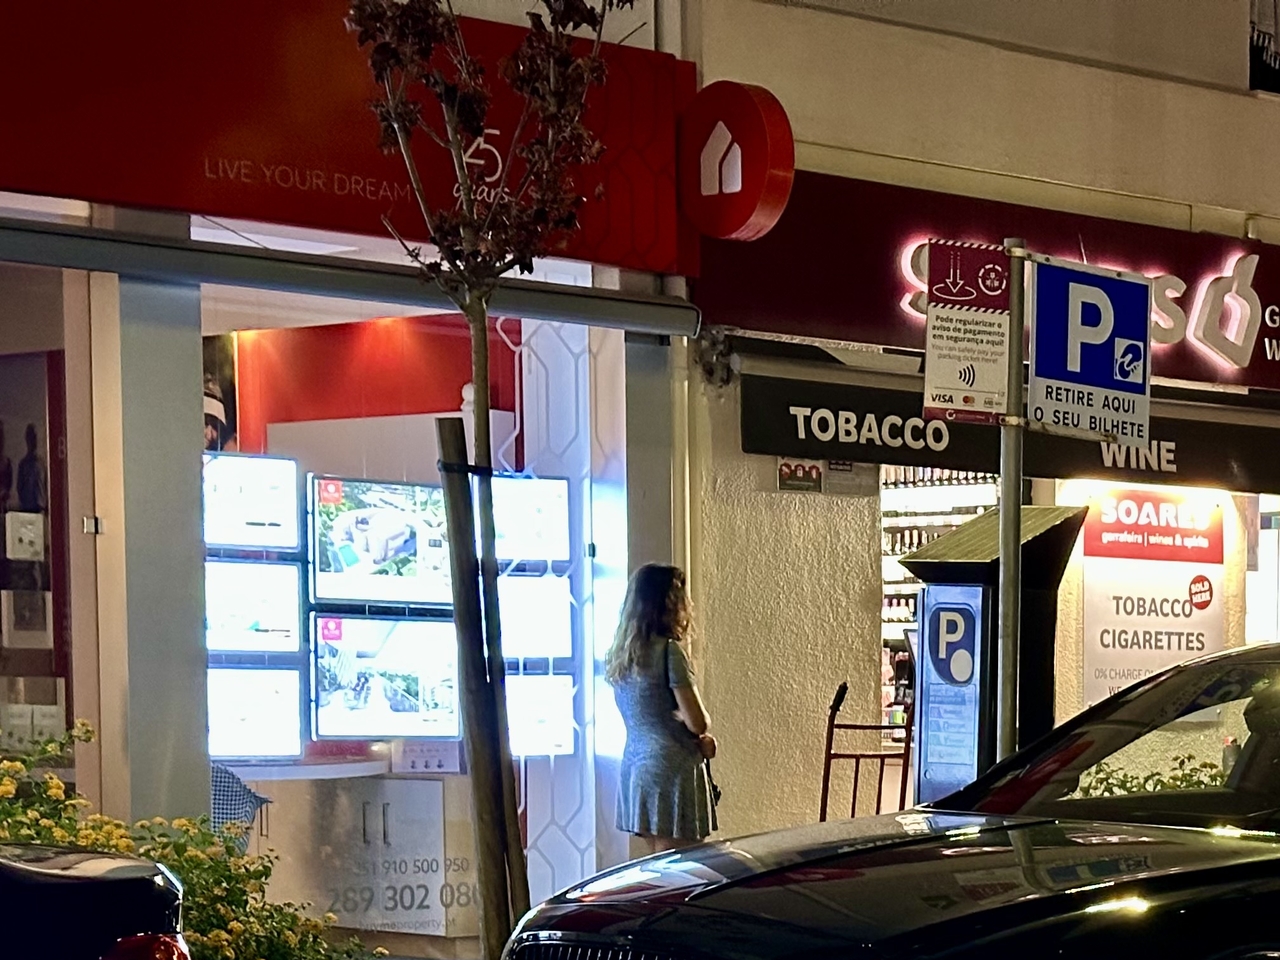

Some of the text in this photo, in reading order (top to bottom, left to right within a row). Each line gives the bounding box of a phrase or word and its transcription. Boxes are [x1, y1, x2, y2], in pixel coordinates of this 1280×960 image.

[204, 157, 411, 204] LIVE YOUR DREAM
[931, 324, 1005, 338] aviso de pagamento
[935, 315, 954, 324] Pode
[955, 318, 996, 329] regularizar
[1066, 281, 1115, 373] P
[946, 335, 984, 345] segurança
[931, 393, 954, 404] VISA
[1045, 385, 1135, 414] RETIRE AQUI
[789, 406, 949, 451] TOBACCO
[1034, 406, 1144, 438] O SEU BILHETE
[1100, 440, 1177, 472] WINE
[1112, 595, 1193, 619] TOBACCO
[938, 611, 966, 659] P
[1099, 628, 1205, 652] CIGARETTES
[1094, 667, 1108, 680] 0%
[1108, 667, 1143, 680] CHARGE
[382, 860, 408, 875] 910
[413, 858, 439, 874] 500
[445, 857, 469, 873] 950
[327, 886, 375, 913] 289
[384, 884, 430, 912] 302
